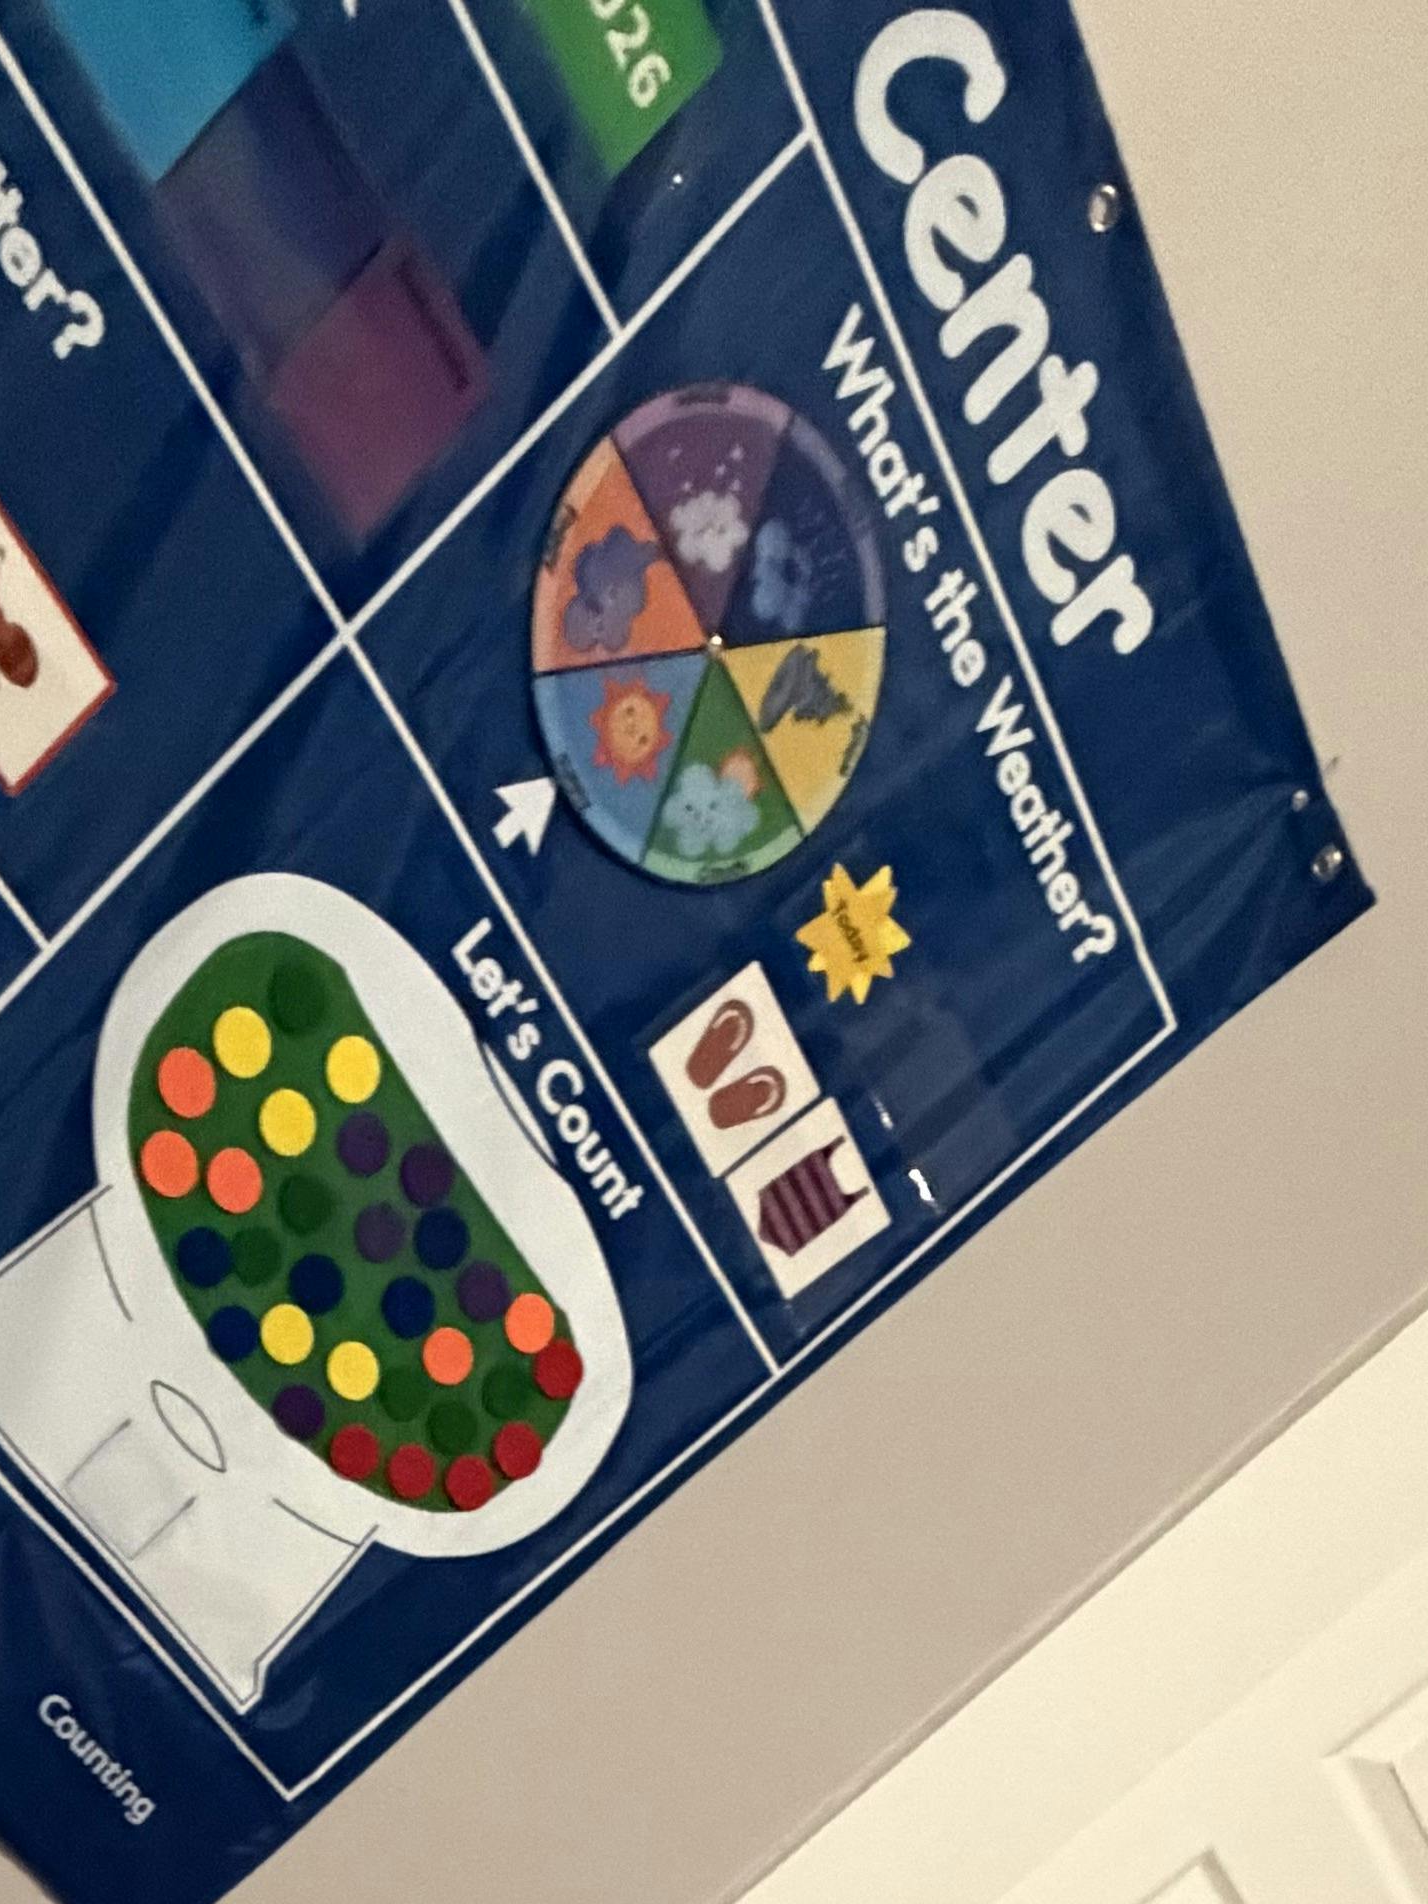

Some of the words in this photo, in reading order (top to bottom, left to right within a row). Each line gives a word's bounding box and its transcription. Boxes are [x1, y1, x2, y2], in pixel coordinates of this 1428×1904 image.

[587, 0, 674, 110] 026
[853, 8, 1156, 657] Center
[822, 303, 943, 575] What's
[924, 568, 986, 688] the
[975, 676, 1119, 965] Weather?
[450, 918, 542, 1064] Let's
[537, 1059, 646, 1222] Count
[37, 1692, 156, 1826] Counting
